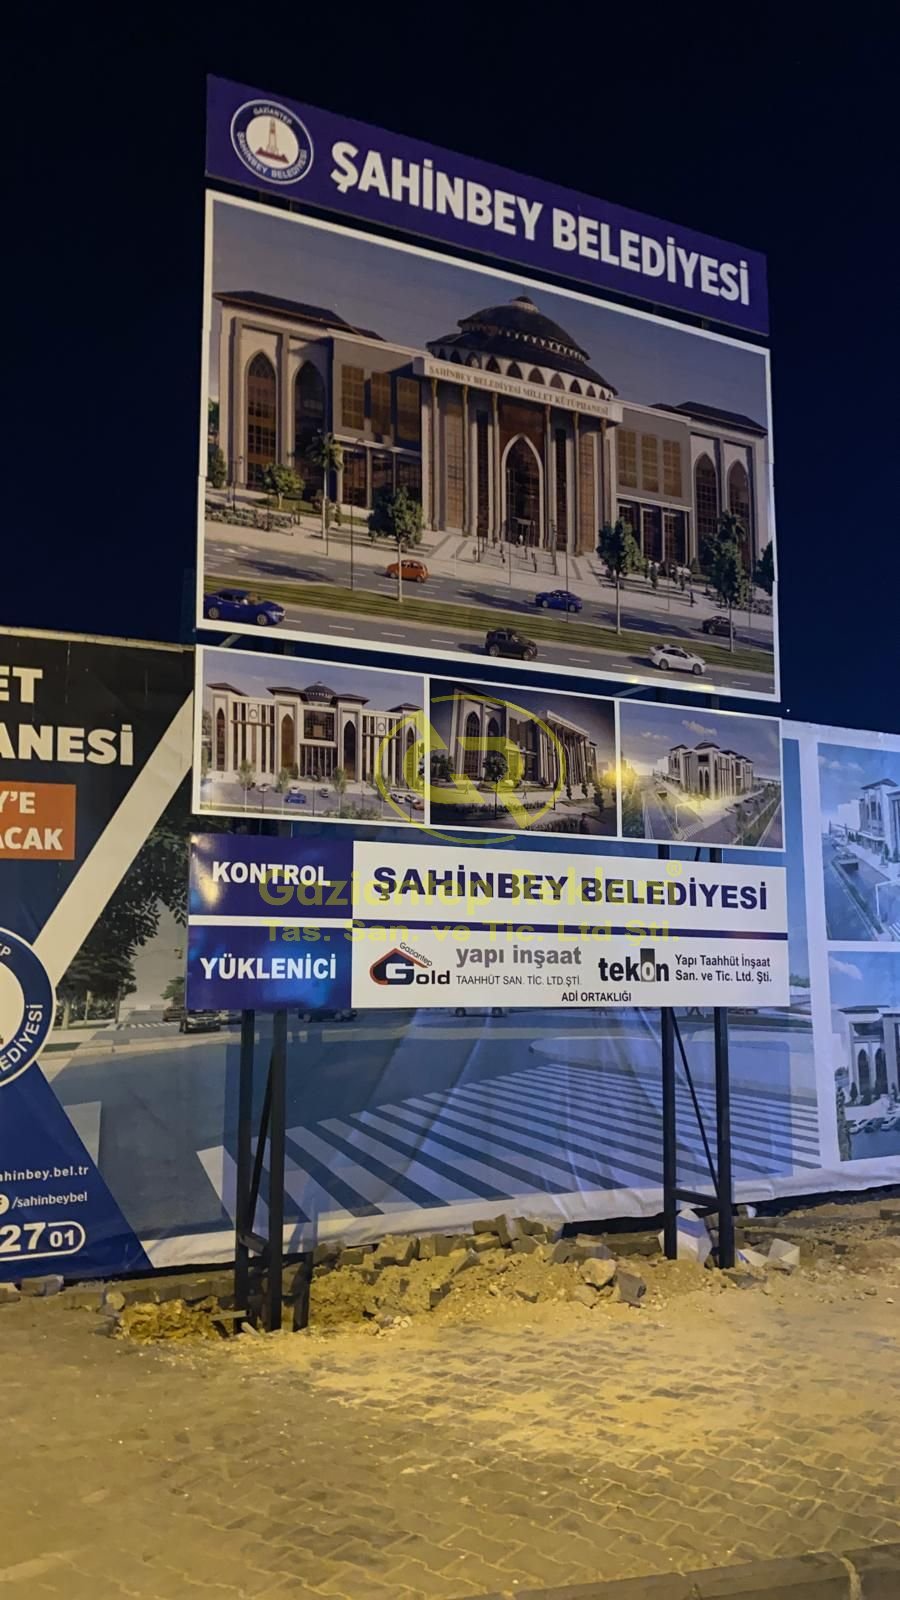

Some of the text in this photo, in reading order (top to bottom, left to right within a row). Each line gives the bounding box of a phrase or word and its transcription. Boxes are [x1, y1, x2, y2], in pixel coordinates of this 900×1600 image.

[330, 140, 750, 306] ŞAHİNBEY BELEDİYESİ
[0, 826, 64, 851] CAK
[213, 861, 331, 886] KONTROL
[373, 864, 767, 910] ŞAHİNBEY BELEDİYESİ
[200, 953, 336, 980] YÜKLENİCİ
[399, 942, 432, 967] Gaziantep
[456, 945, 582, 969] yapı inşaat
[675, 953, 771, 969] Yapı Taahhüt İnşaat
[384, 962, 450, 986] Gold
[456, 975, 501, 986] TAAHHÜT
[503, 976, 525, 985] SAN.
[598, 955, 669, 982] tekon
[675, 970, 772, 984] San. ve Tic. Ltd. Şti.
[561, 990, 632, 1003] ADİ ORTAKLIĞI
[50, 1229, 74, 1247] 01
